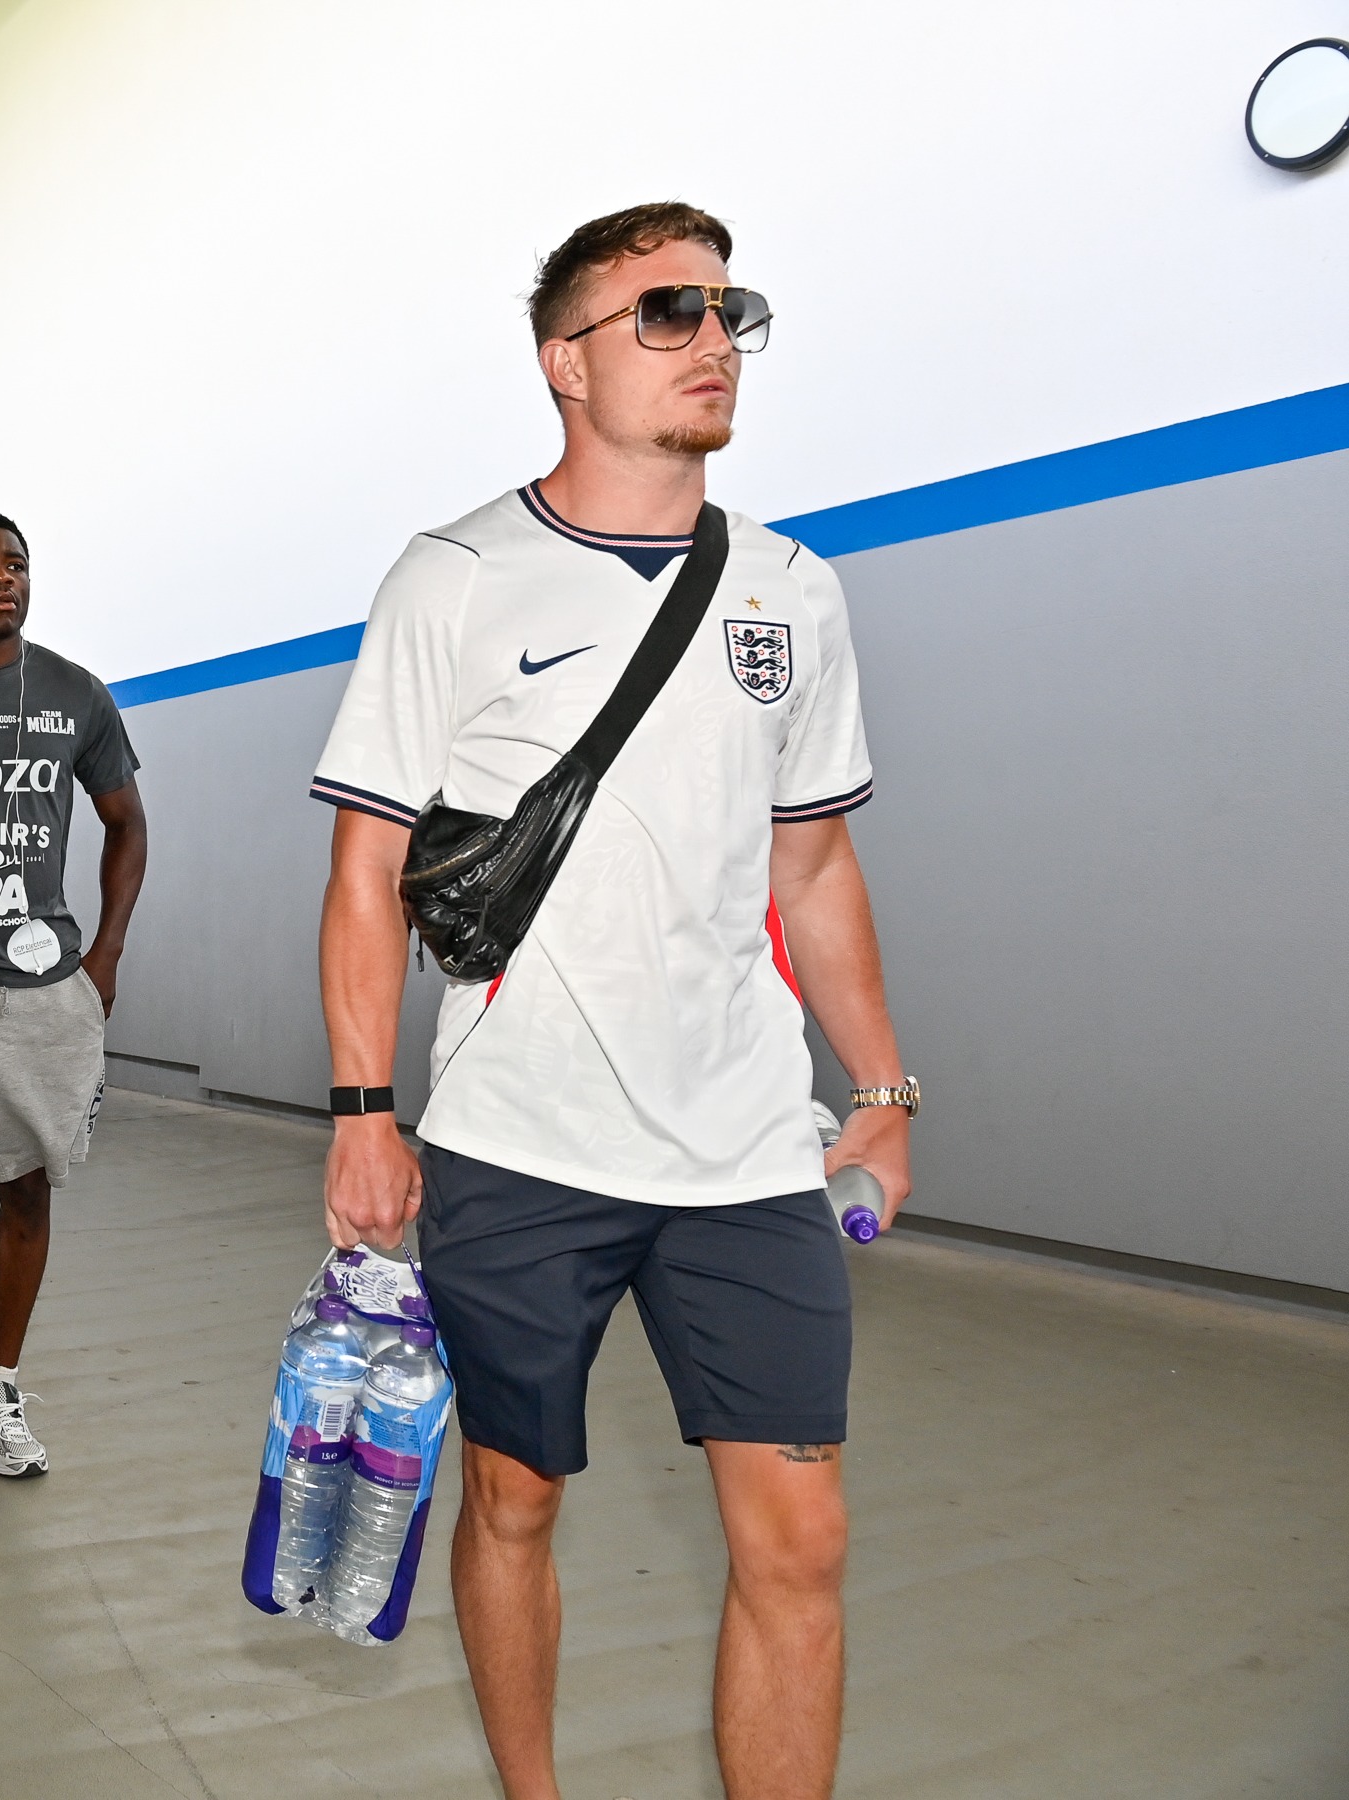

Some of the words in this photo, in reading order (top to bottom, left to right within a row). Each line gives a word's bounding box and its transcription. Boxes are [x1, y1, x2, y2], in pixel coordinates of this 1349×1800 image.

[40, 710, 62, 718] TEAM
[26, 716, 76, 736] MULLA
[374, 1475, 393, 1485] PRODUCT
